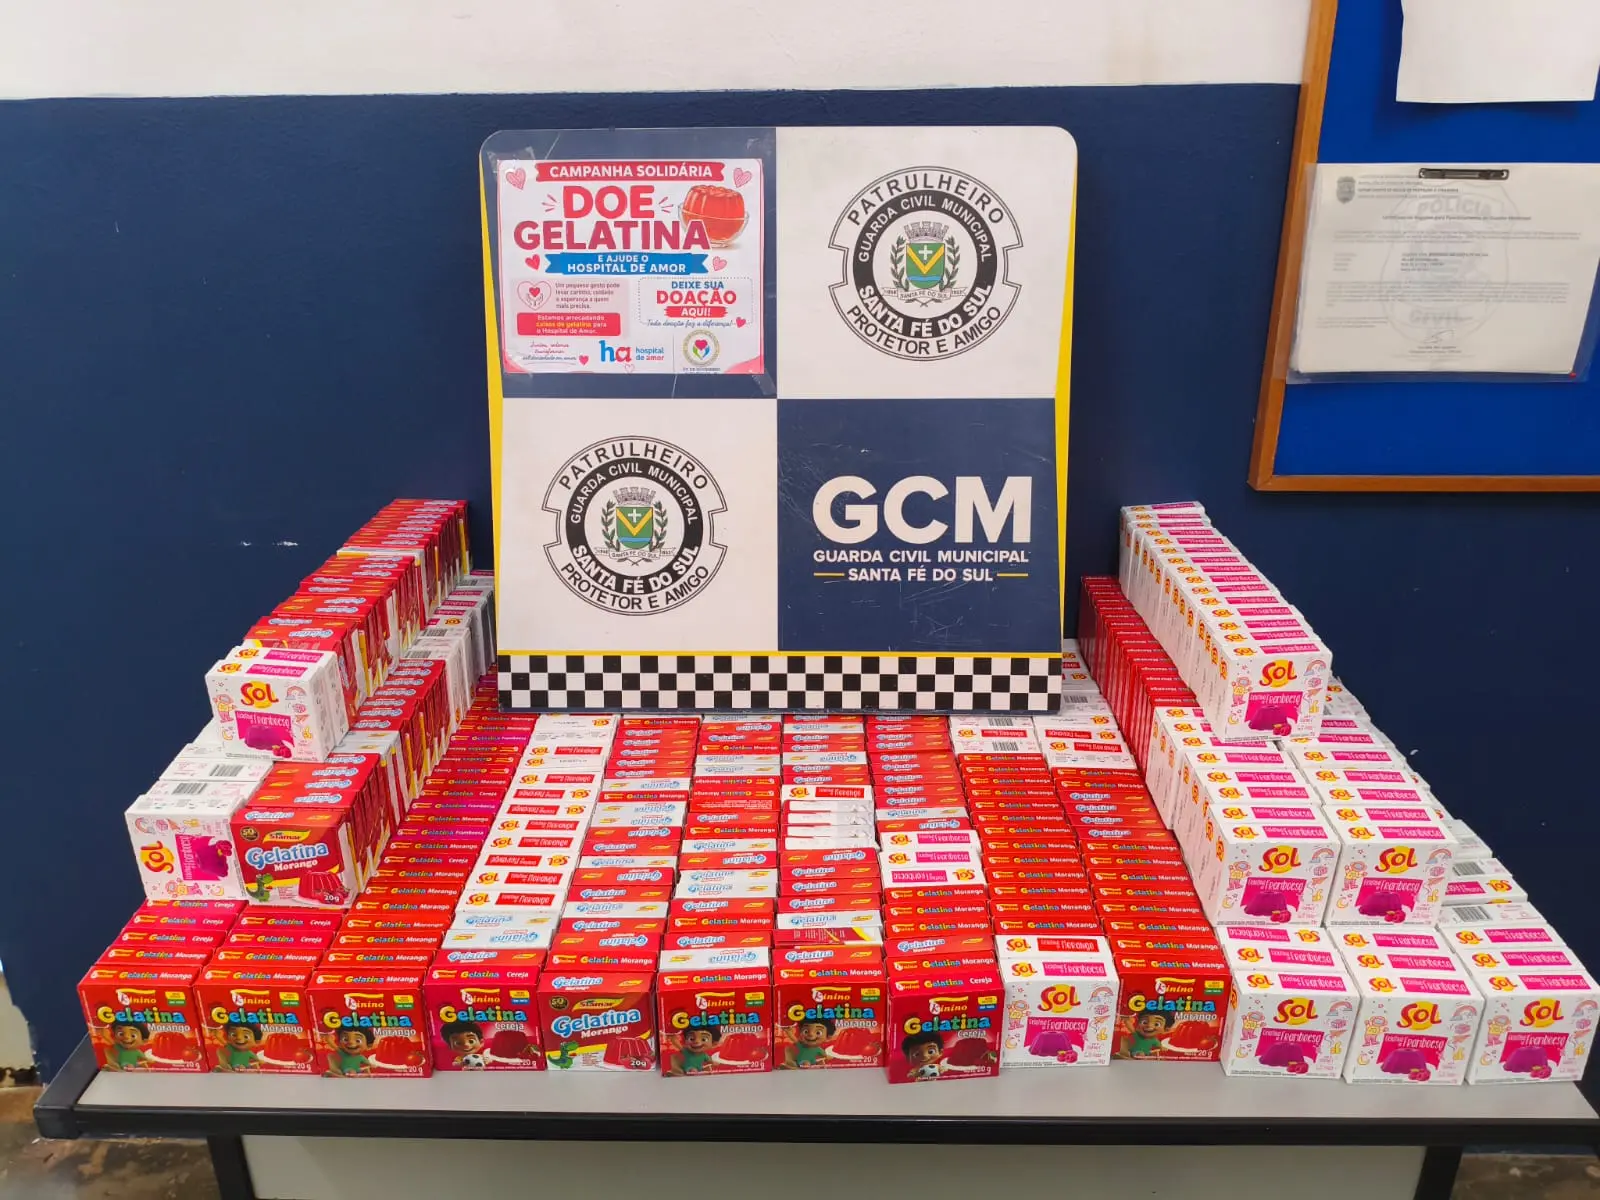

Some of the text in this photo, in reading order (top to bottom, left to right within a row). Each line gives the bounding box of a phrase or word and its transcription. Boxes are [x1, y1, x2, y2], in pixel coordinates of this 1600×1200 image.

[549, 162, 713, 178] CAMPANHA SOLIDÁRIA
[562, 185, 655, 219] DOE
[847, 172, 1004, 226] PATRULHEIRO
[513, 220, 711, 251] GELATINA
[858, 194, 992, 263] GUARDA CIVIL MUNICIPAL
[567, 262, 686, 273] HOSPITAL DE AMOR
[597, 254, 649, 263] E AJUDE O
[671, 281, 724, 289] DEIXE SUA
[656, 288, 737, 307] DOAÇÃO
[680, 308, 711, 318] AQUI!
[859, 284, 992, 337] SANTA FÉ DO SUL
[846, 304, 1001, 356] PROTETOR E AMIGO
[598, 340, 632, 362] ha
[635, 346, 664, 354] hospital
[558, 442, 708, 490] PATRULHEIRO
[570, 462, 699, 525] GUARDA CIVIL MUNICIPAL
[812, 475, 1032, 544] GCM
[813, 550, 1029, 563] GUARDA CIVIL MUNICIPAL
[572, 545, 700, 594] SANTA FÉ DO SUL
[848, 565, 993, 582] SANTA FÉ DO SUL
[560, 563, 709, 611] PROTETOR E AMIGO
[1259, 660, 1298, 687] SOL
[241, 682, 279, 707] SOL
[245, 843, 329, 870] Gelatina
[1258, 847, 1303, 873] SOL
[1375, 847, 1419, 874] SOL
[274, 860, 318, 872] Morango
[809, 969, 882, 977] Gelatina Morango
[1011, 962, 1038, 977] SOL
[1151, 961, 1225, 970] Gelatina Morango
[1247, 974, 1274, 988] SOL
[1037, 986, 1081, 1012] SOL
[1128, 995, 1216, 1012] Gelatina
[97, 1006, 186, 1024] Gelatina
[211, 1007, 298, 1024] Gelatina
[323, 1011, 412, 1029] Gelatina
[439, 1005, 526, 1023] Gelatina
[671, 1010, 760, 1030] Gelatina
[787, 1003, 875, 1022] Gelatina
[1174, 1012, 1217, 1021] Morango
[1273, 998, 1319, 1025] SOL
[1396, 1003, 1442, 1029] SOL
[1519, 1000, 1564, 1026] SOL
[147, 1023, 191, 1033] Morango
[260, 1024, 303, 1033] Morango
[373, 1028, 416, 1037] Morango
[495, 1022, 525, 1032] Cereja
[551, 1009, 641, 1038] Gelatina
[581, 1026, 629, 1038] Morango
[720, 1024, 763, 1034] Morango
[835, 1020, 878, 1029] Morango
[904, 1013, 991, 1035] Gelatina
[957, 1030, 986, 1038] Cereja
[186, 1061, 194, 1069] 20
